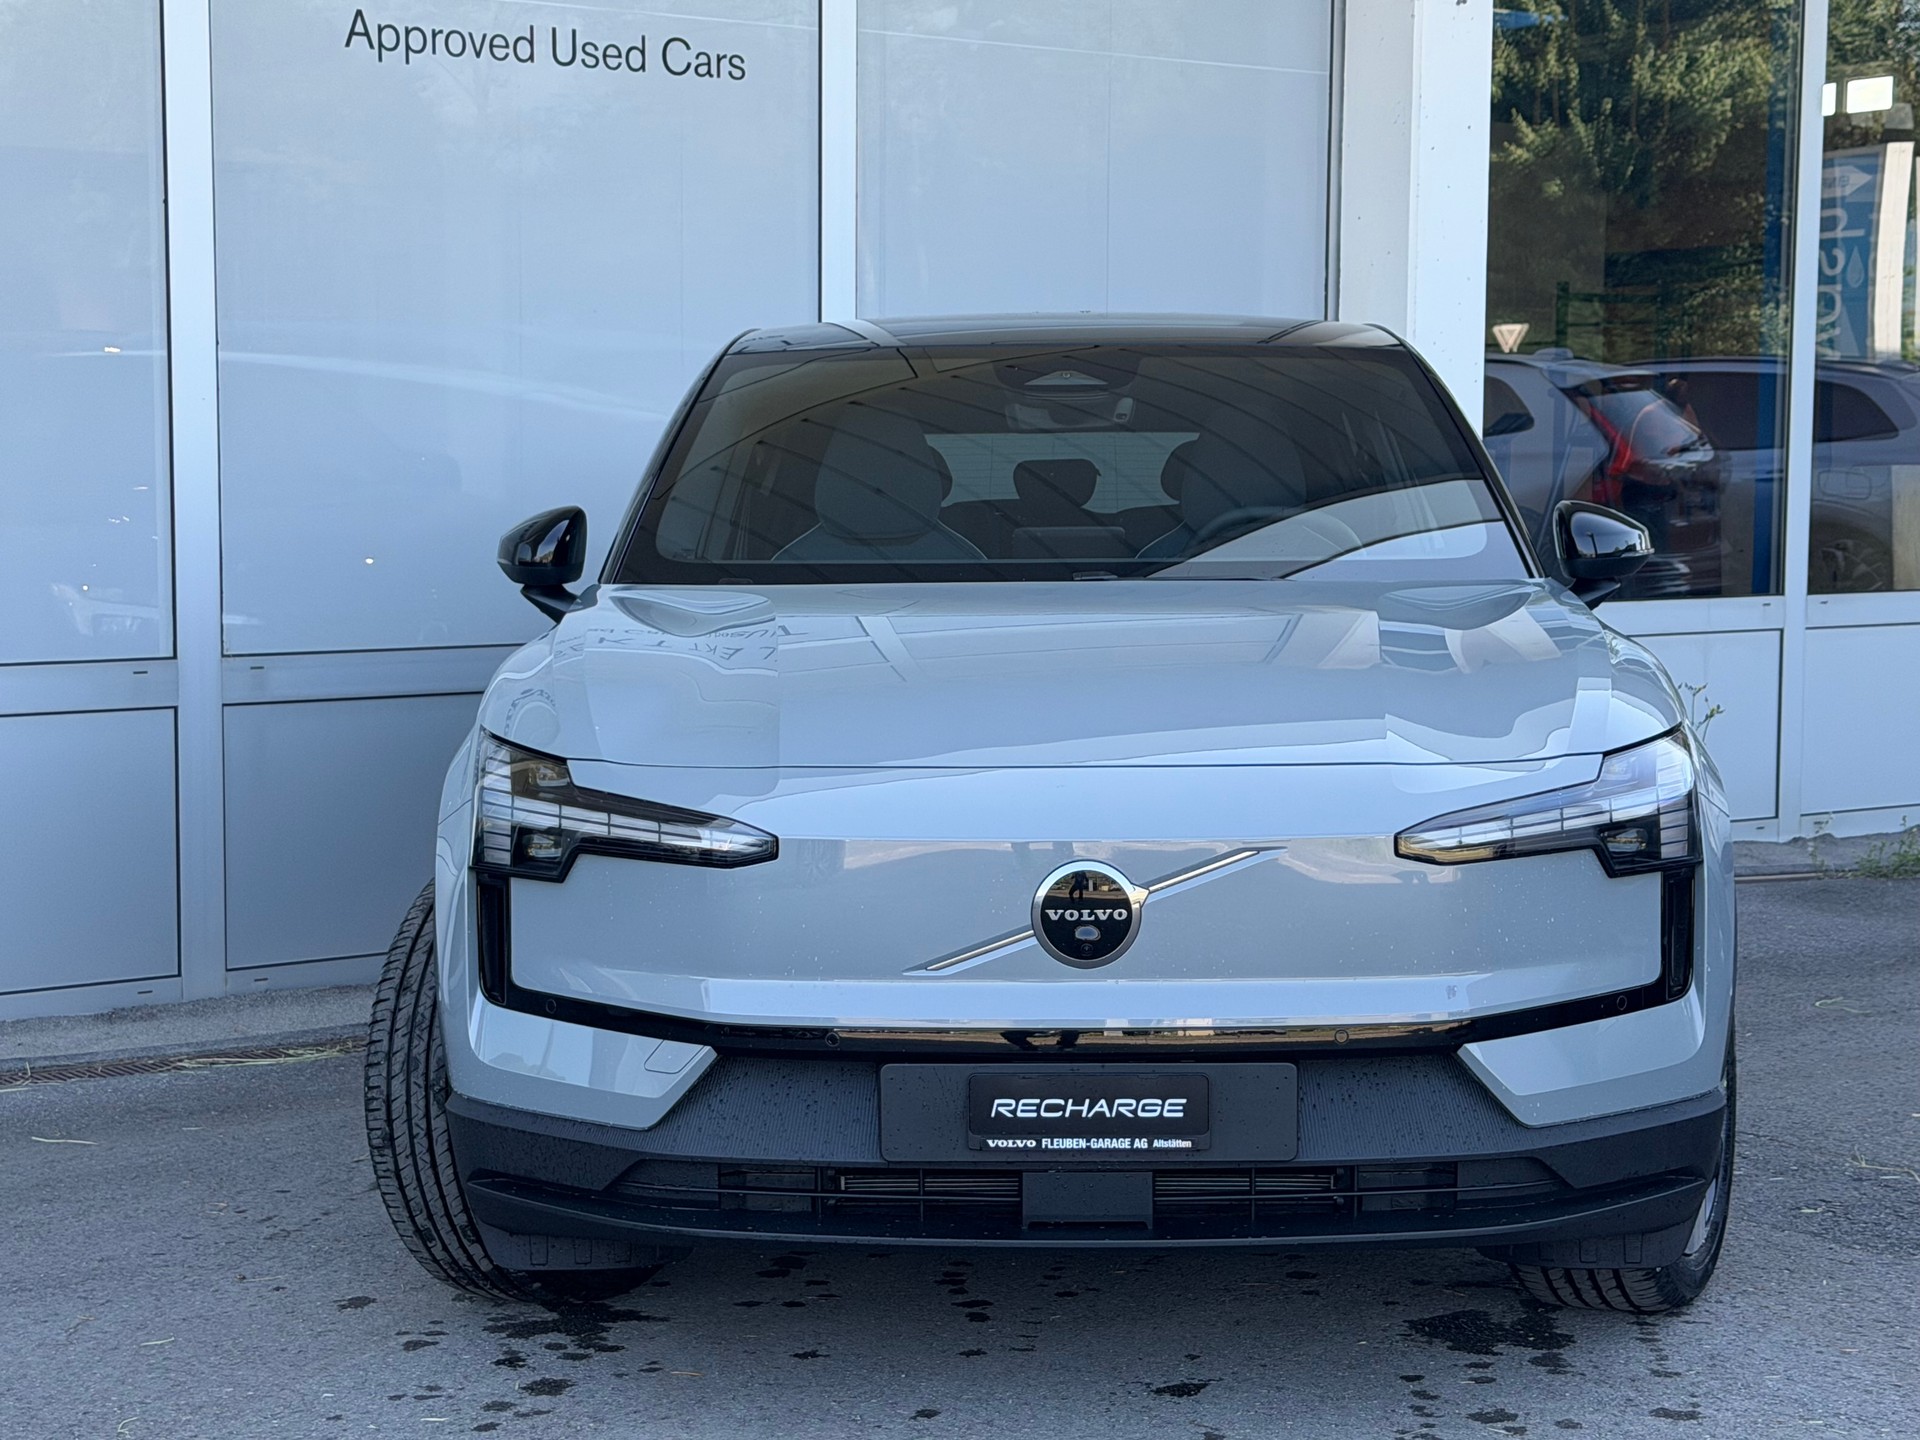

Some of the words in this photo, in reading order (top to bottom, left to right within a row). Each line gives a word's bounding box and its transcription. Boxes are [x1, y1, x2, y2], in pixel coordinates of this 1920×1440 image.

[344, 8, 535, 65] Approved
[550, 25, 647, 73] Used
[661, 36, 747, 81] Cars
[1044, 908, 1129, 921] VOLVO
[990, 1098, 1188, 1118] RECHARGE
[986, 1138, 1037, 1148] VOLVO
[1041, 1138, 1132, 1149] FLEUBEN-GARAGE
[1133, 1138, 1148, 1149] AG
[1152, 1138, 1192, 1149] Altstätten
